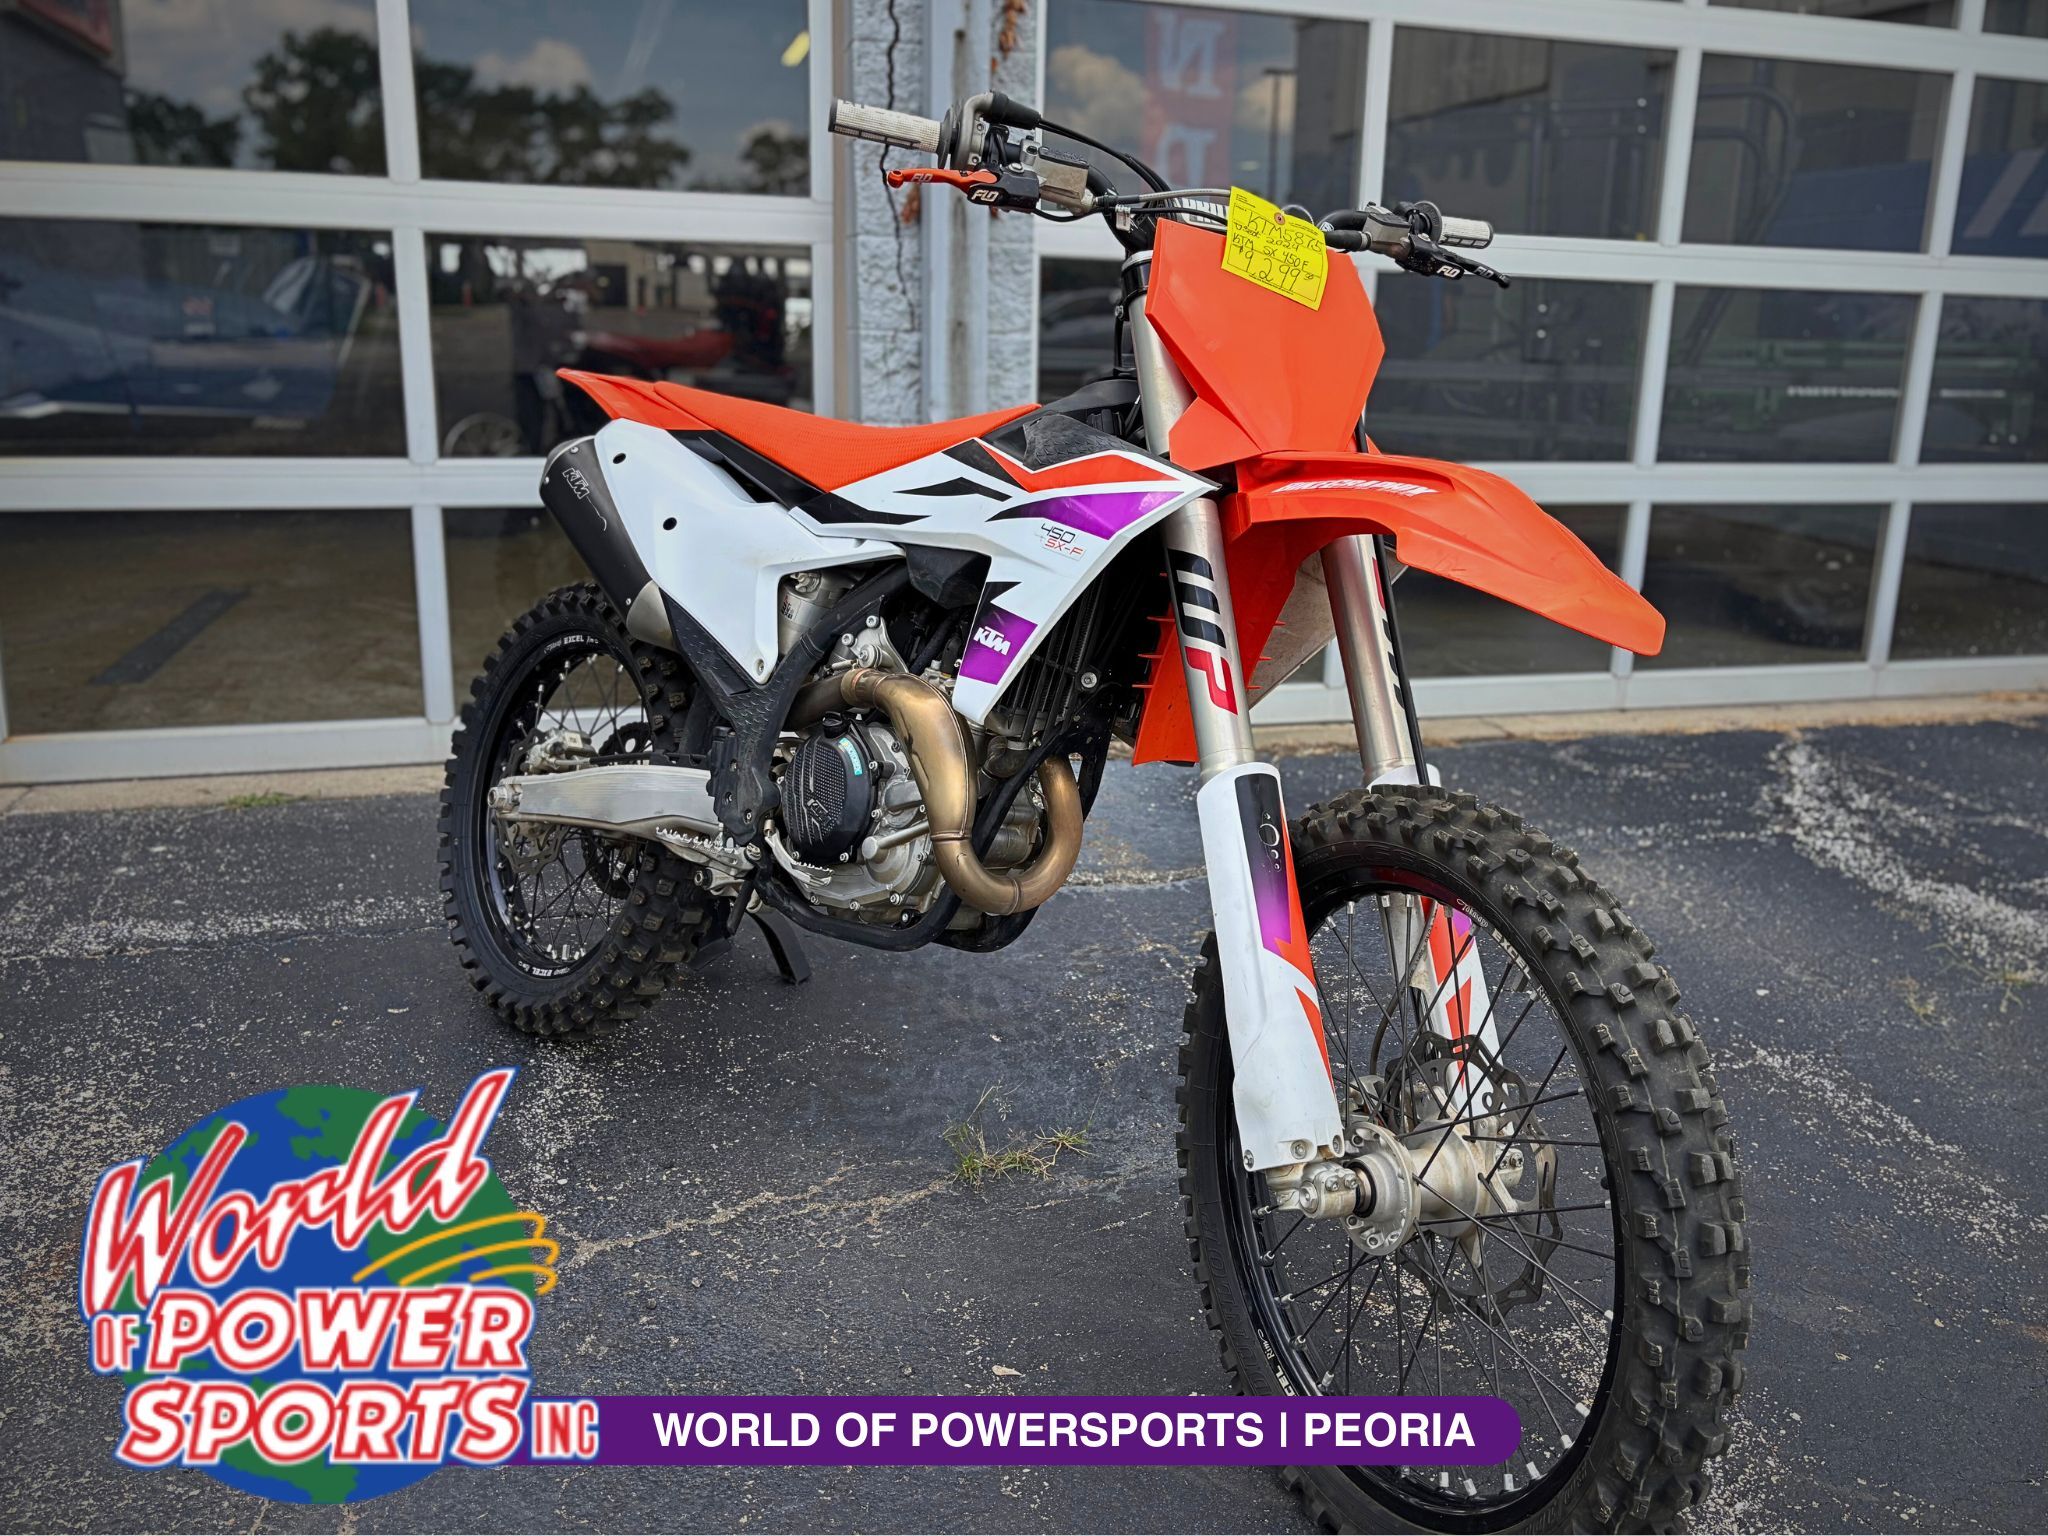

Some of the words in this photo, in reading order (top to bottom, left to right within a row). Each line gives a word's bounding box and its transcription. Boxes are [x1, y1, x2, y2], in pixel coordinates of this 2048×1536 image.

[971, 189, 999, 202] FLO
[1232, 232, 1254, 251] KTM
[1436, 265, 1461, 278] FLO
[562, 467, 591, 499] KTM
[1040, 522, 1076, 544] 450
[1044, 537, 1084, 555] SX-F
[973, 625, 1011, 656] KTM
[1491, 928, 1532, 980] EXCEL
